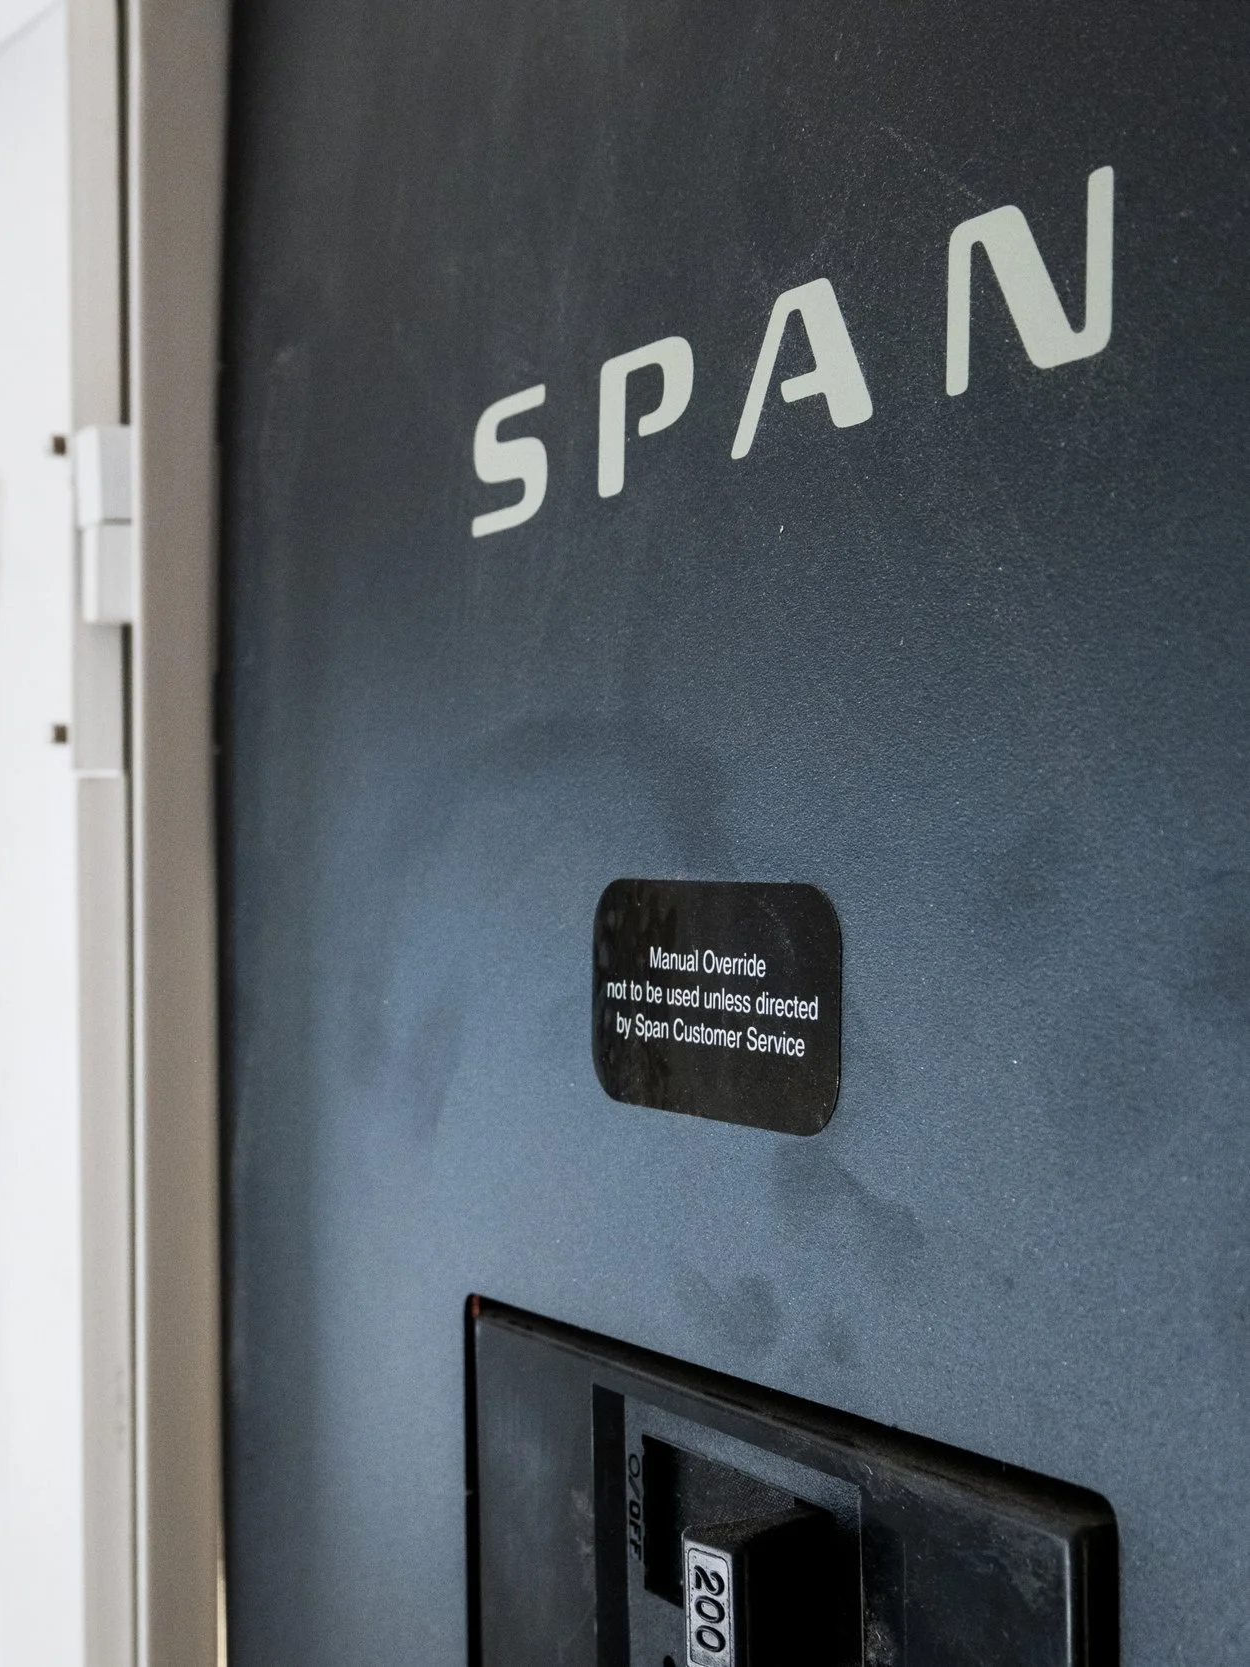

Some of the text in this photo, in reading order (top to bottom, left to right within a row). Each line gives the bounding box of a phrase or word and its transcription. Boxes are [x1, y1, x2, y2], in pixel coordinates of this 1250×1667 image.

[472, 165, 1114, 537] SPAN
[650, 946, 766, 978] Manual Override
[607, 979, 819, 1021] not to be used unless directed
[616, 1012, 805, 1057] by Span Customer Service
[694, 1564, 726, 1653] 200
